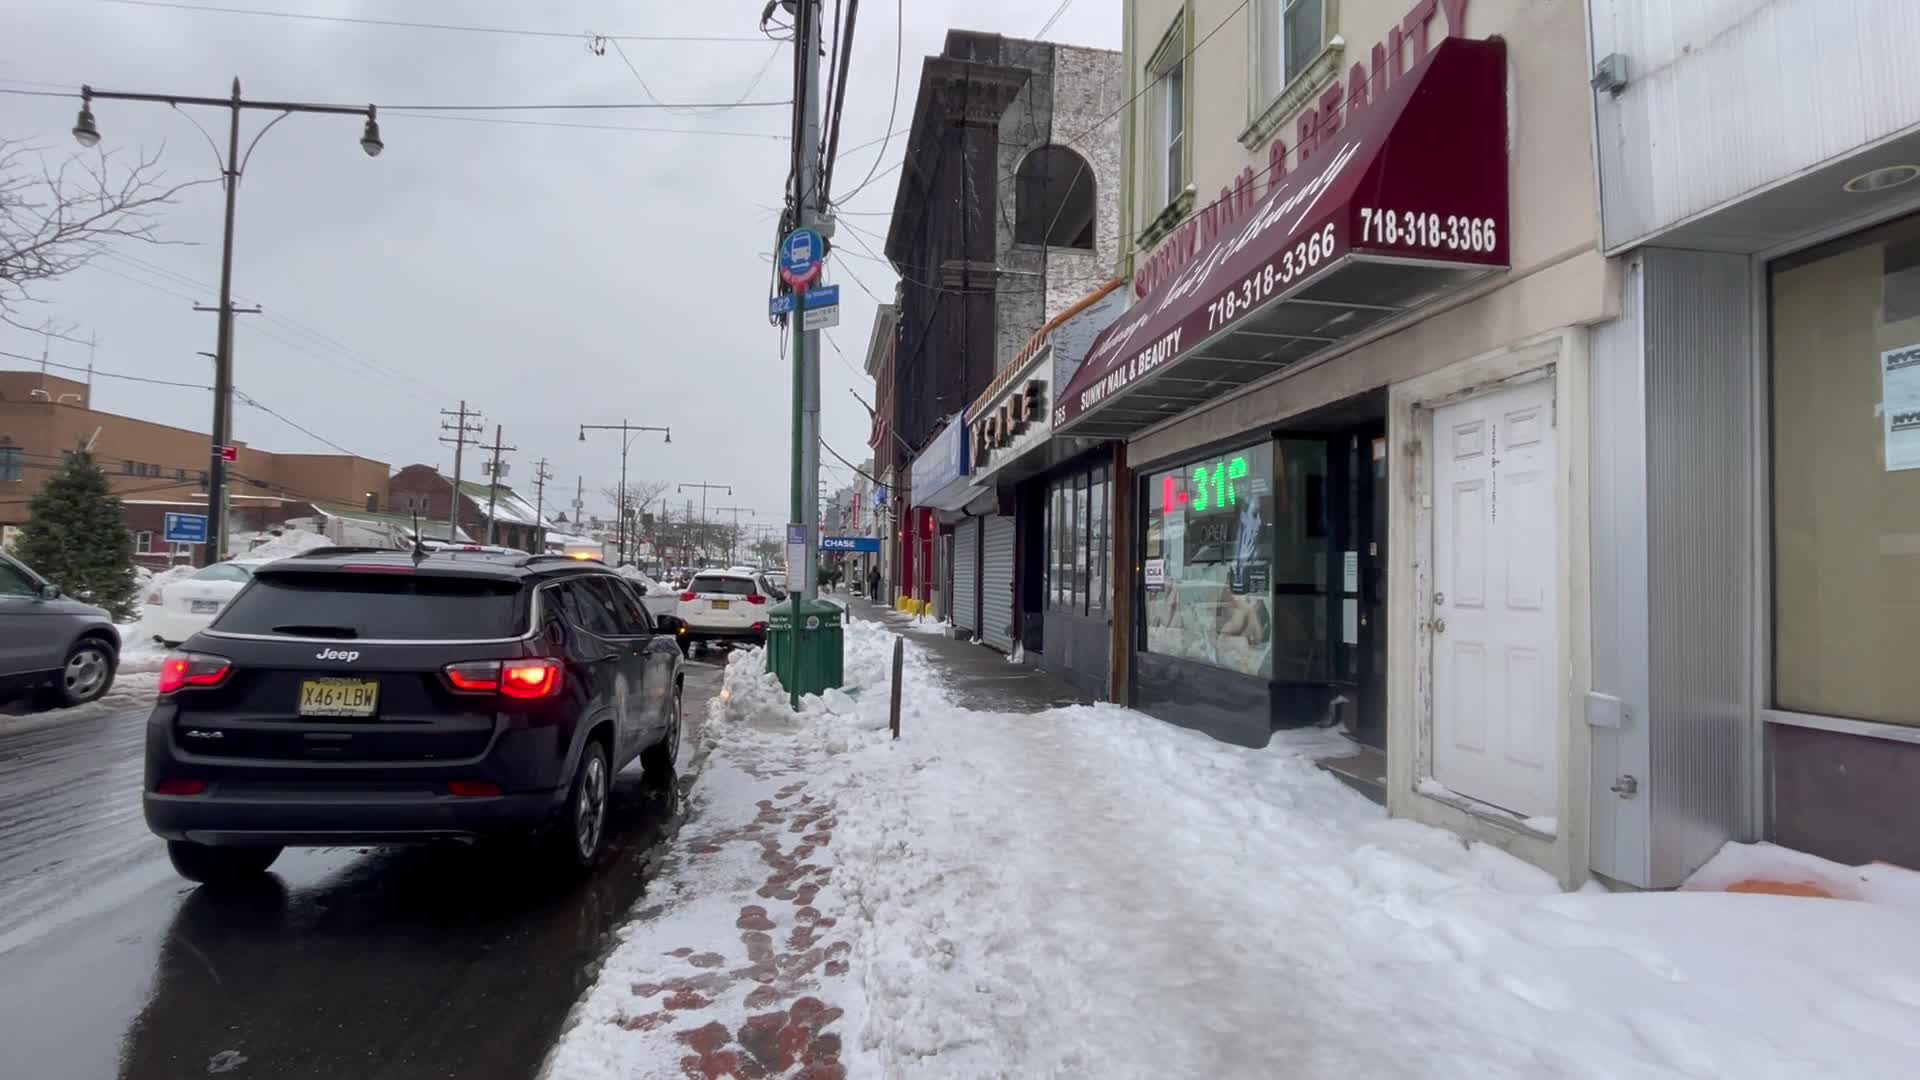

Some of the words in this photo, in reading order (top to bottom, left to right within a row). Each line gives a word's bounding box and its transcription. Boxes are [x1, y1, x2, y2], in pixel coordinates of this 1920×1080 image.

[1361, 207, 1496, 252] 718-318-3366
[1208, 221, 1335, 331] 718-318-3366
[1054, 405, 1066, 427] 265
[1080, 377, 1107, 411] SUNNY
[1107, 365, 1127, 395] NAIL
[1129, 359, 1136, 380] &
[1138, 327, 1182, 376] BEAUTY
[1200, 523, 1228, 541] OPEN
[824, 539, 855, 548] CHASE
[316, 647, 360, 662] Jeep
[304, 687, 333, 706] X46
[343, 687, 374, 706] LBW
